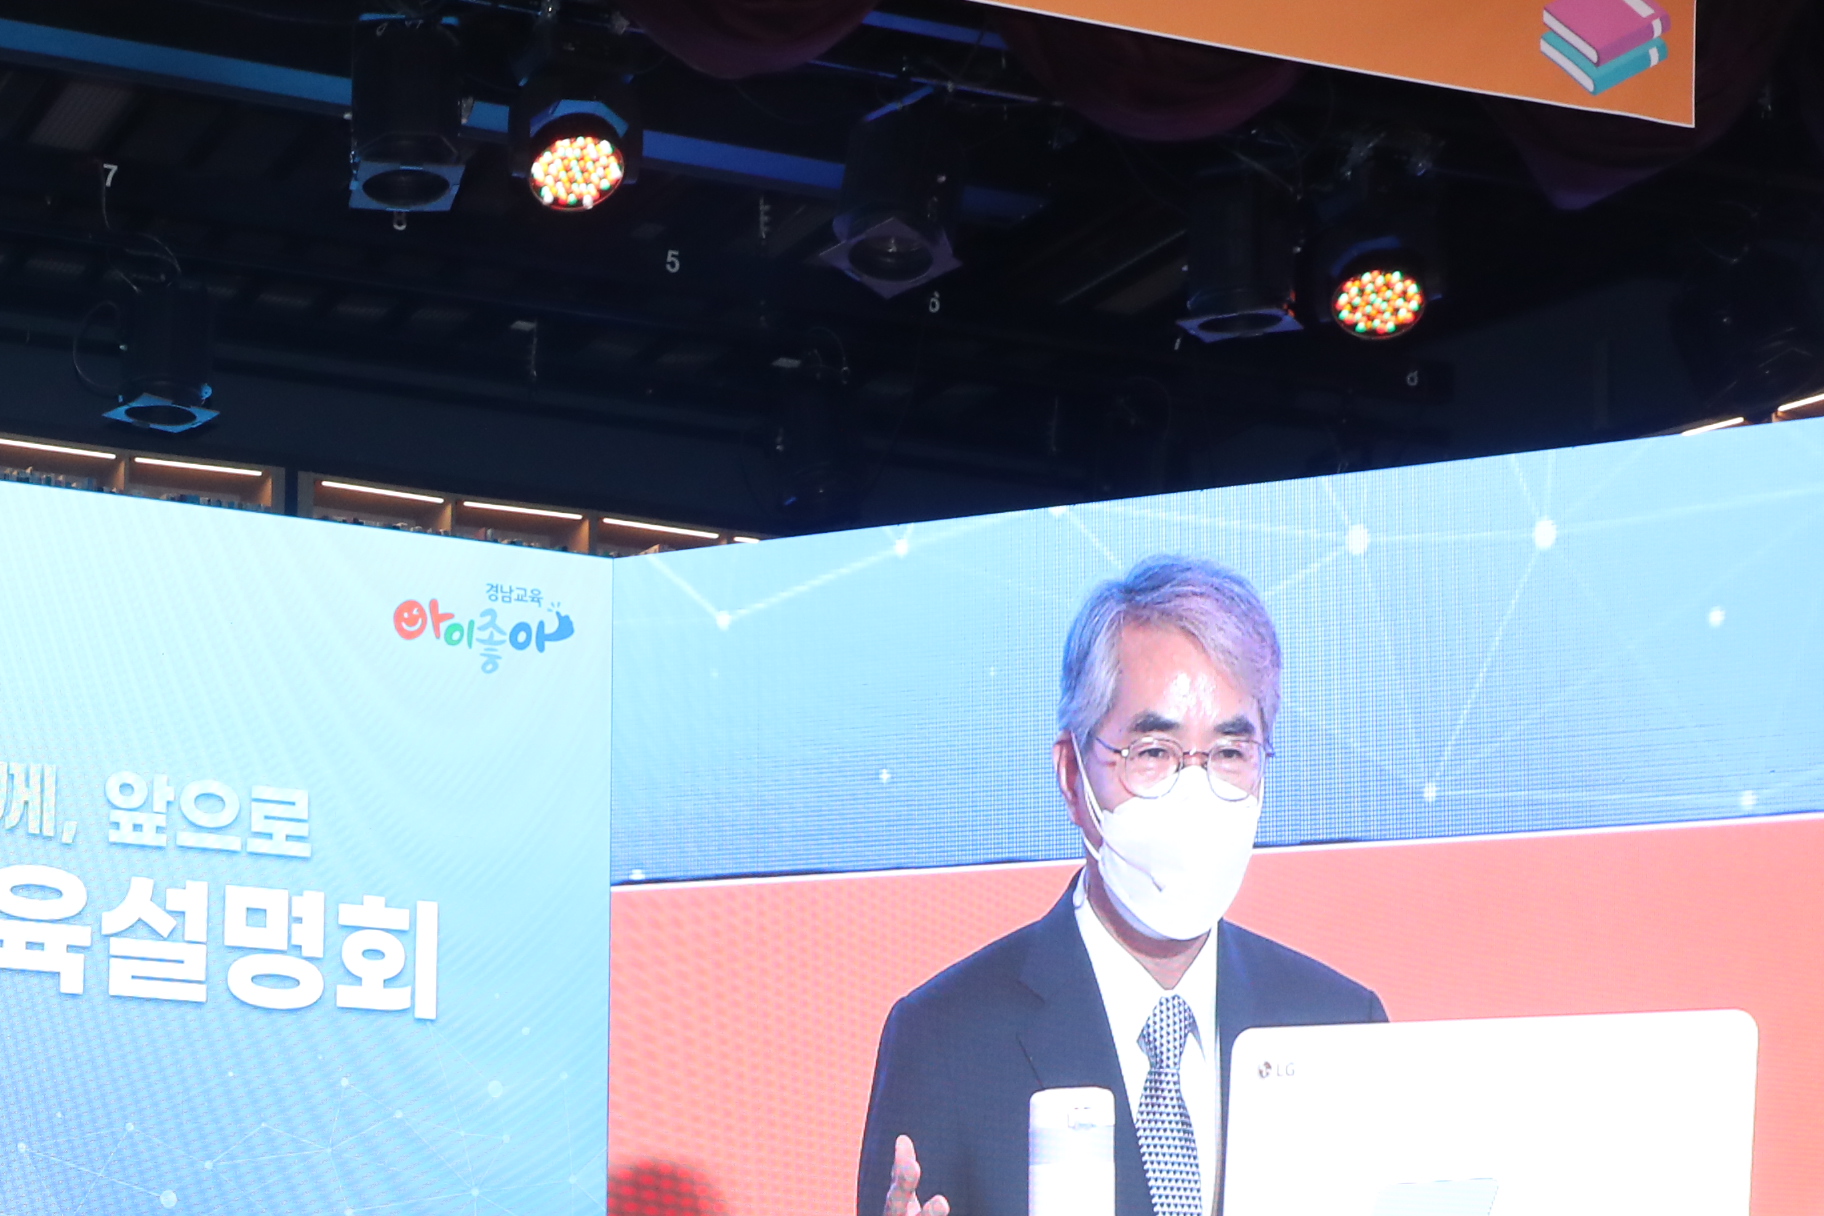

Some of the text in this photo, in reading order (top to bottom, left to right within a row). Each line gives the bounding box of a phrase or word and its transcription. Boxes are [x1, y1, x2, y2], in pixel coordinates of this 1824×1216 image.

[102, 163, 118, 189] 7
[665, 250, 680, 274] 5
[485, 582, 544, 608] 경남교육
[393, 598, 575, 674] 아이좋아
[103, 770, 314, 861] 앞으로
